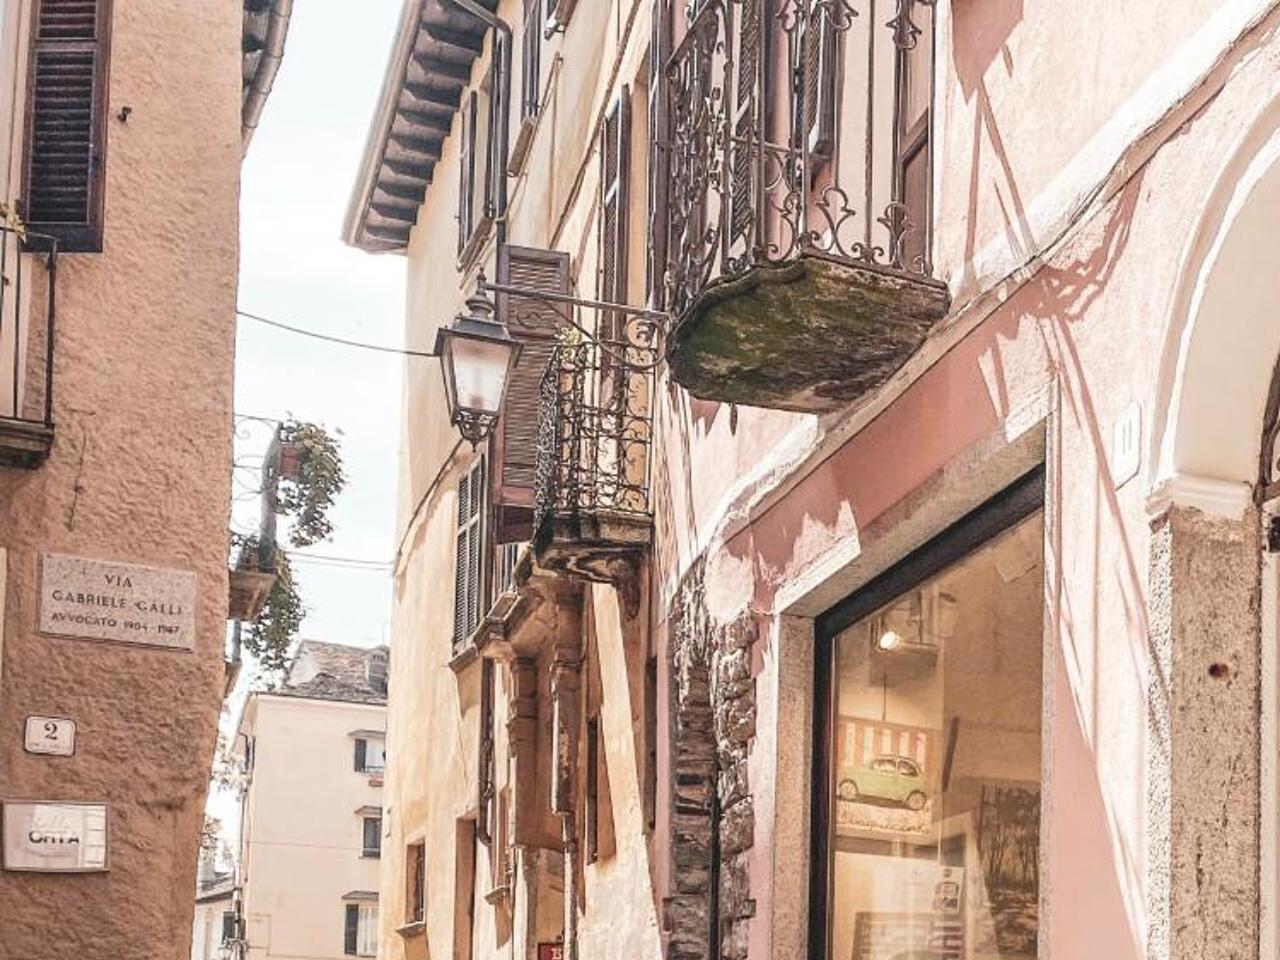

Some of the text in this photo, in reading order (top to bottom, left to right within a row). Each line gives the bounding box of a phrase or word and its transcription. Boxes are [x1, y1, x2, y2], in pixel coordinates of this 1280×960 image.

[104, 574, 133, 588] VIA
[52, 590, 183, 616] GABRIELE GALLI
[51, 612, 118, 628] AVVOCATO
[43, 722, 58, 740] 2
